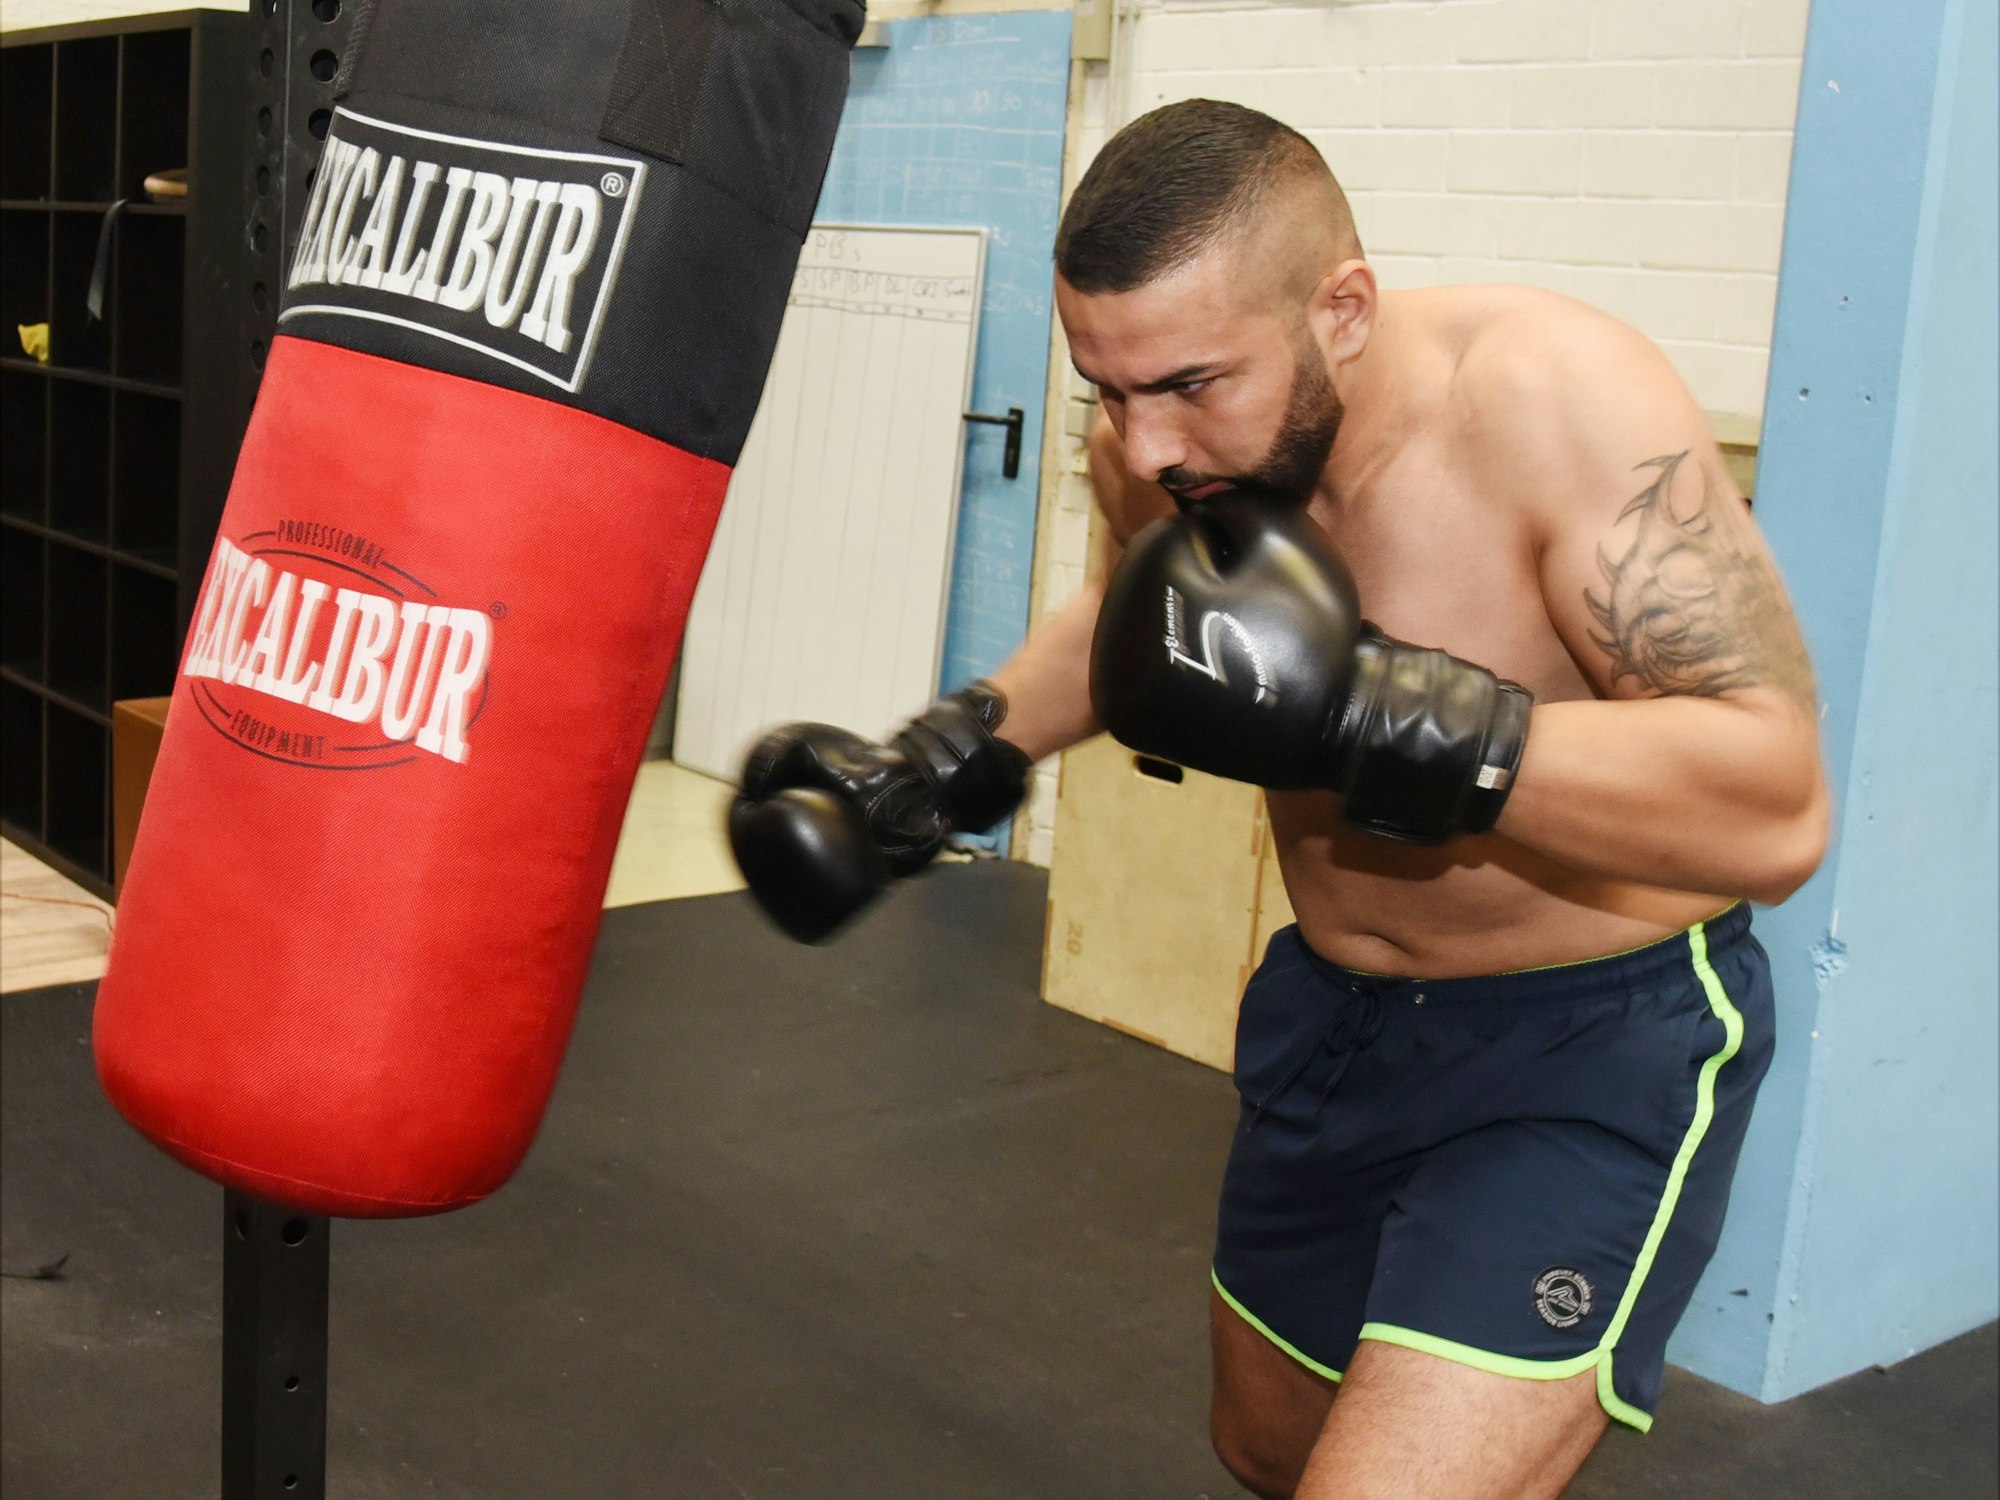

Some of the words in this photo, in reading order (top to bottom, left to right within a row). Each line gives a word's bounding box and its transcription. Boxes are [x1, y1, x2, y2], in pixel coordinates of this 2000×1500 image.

[287, 134, 603, 354] EXCALIBUR
[275, 519, 385, 570] PROFESSIONAL
[182, 536, 492, 765] EXCALIBUR
[1163, 595, 1180, 649] Elements
[1222, 611, 1269, 686] mma-fashion
[228, 708, 326, 759] EQUIPMENT
